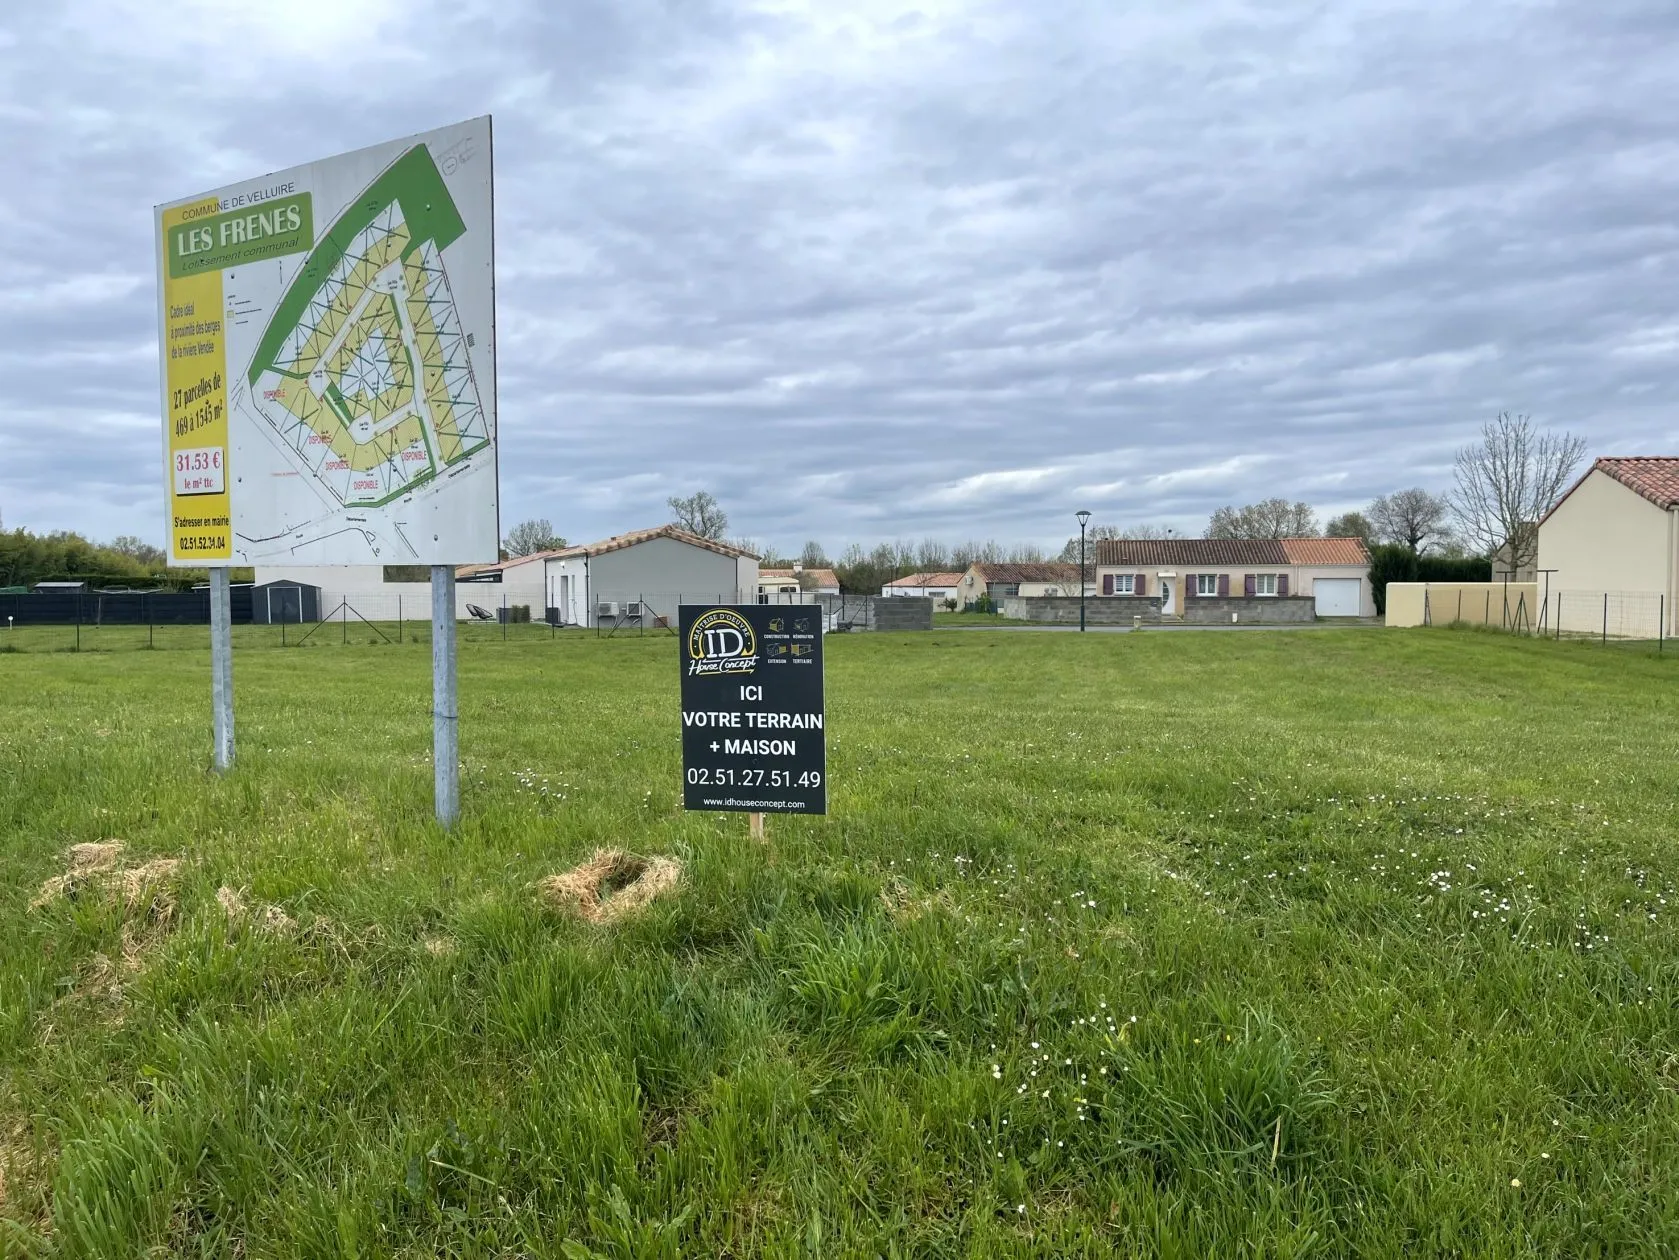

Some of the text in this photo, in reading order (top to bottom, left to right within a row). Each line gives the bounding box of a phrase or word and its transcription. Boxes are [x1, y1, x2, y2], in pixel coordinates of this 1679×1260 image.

[182, 182, 295, 220] COMMUNE DE VELLUIRE
[177, 204, 301, 256] LES FRENES
[182, 237, 299, 271] Lotissement communal
[205, 319, 220, 336] berges
[174, 371, 221, 410] 27 parcelles de
[176, 416, 188, 438] 469
[196, 404, 213, 428] 1545
[176, 451, 221, 472] 31.53 €
[402, 450, 428, 462] DISPONIBLE
[184, 478, 191, 489] le
[204, 477, 214, 488] ttc
[353, 479, 379, 491] DISPONIBLE
[174, 514, 230, 528] S'adresser en mairie
[719, 613, 751, 637] D'OEUVRE
[704, 628, 743, 658] ID
[689, 655, 760, 676] House Concept
[740, 685, 763, 701] ICI
[682, 711, 823, 729] VOTRE TERRAIN
[709, 738, 796, 756] + MAISON
[687, 767, 821, 788] 02.51.27.51.49
[703, 797, 806, 809] www.idhouseconcept.com
